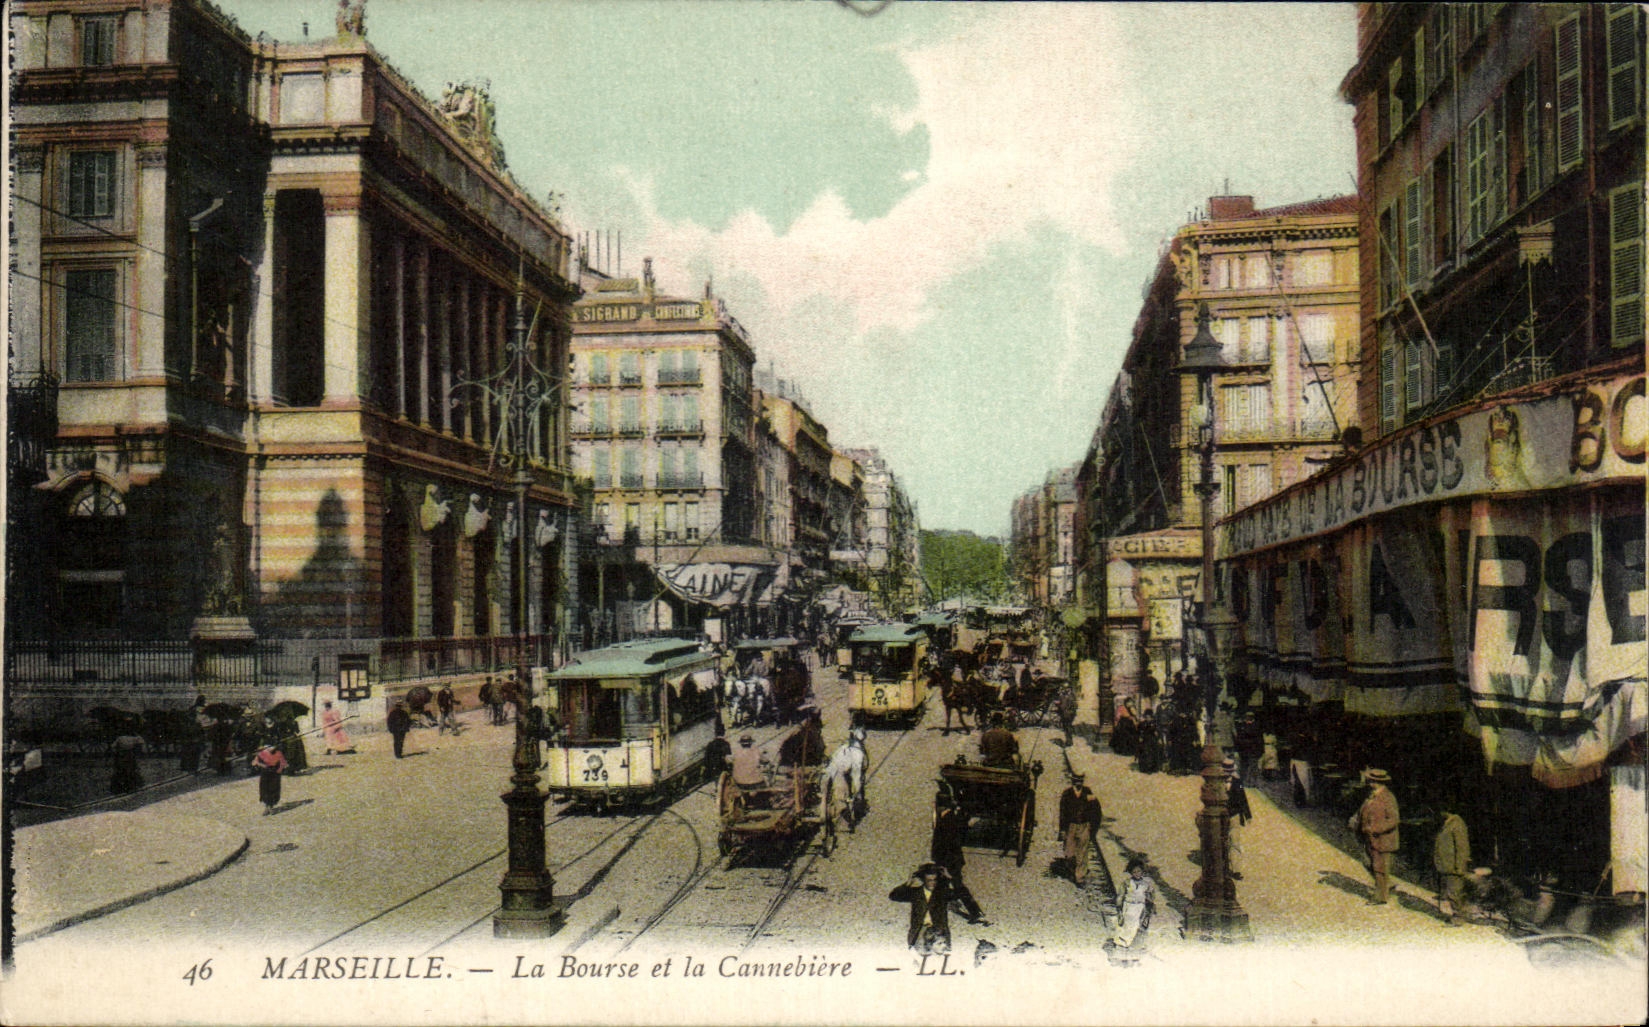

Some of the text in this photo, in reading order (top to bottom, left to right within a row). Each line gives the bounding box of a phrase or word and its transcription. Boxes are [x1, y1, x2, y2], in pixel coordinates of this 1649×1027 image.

[583, 305, 638, 321] SIGRAND
[1351, 419, 1464, 514] BOURSE
[583, 769, 608, 781] 739
